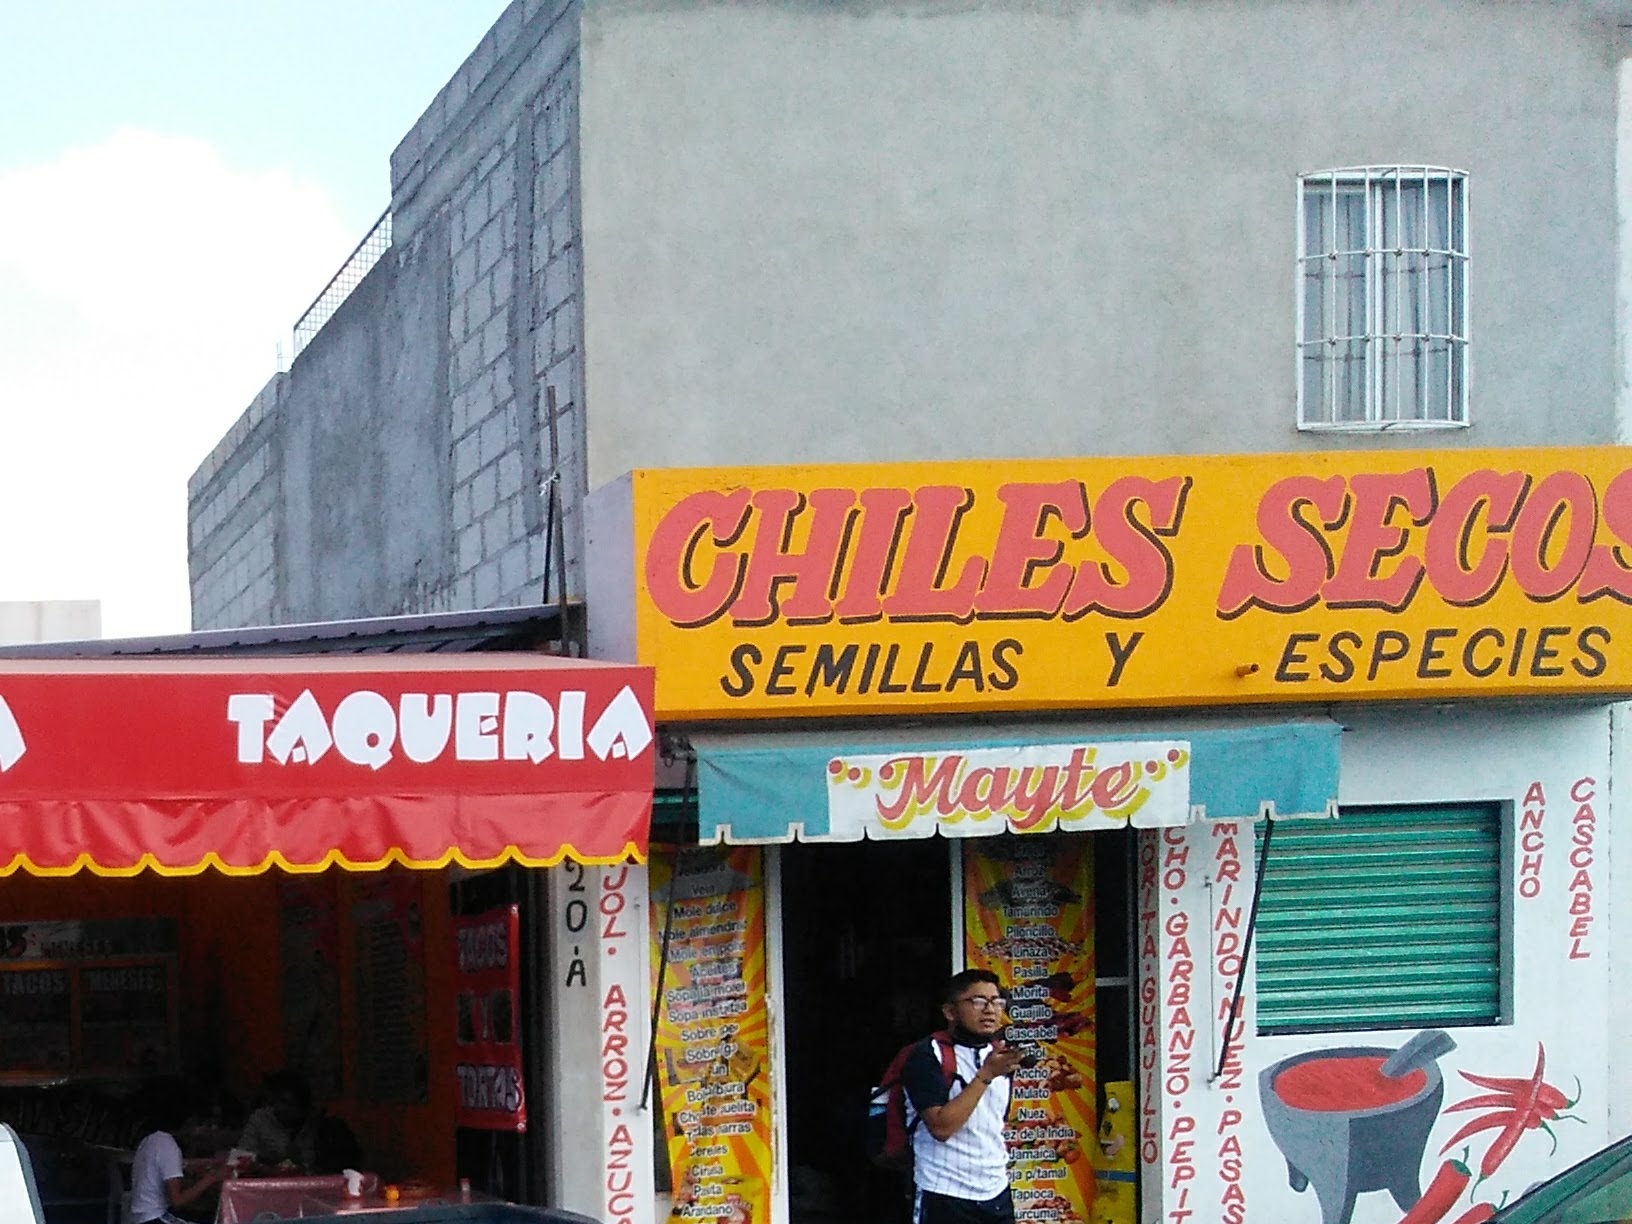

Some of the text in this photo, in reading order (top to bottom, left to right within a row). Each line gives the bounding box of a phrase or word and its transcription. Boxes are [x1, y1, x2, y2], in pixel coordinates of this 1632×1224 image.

[645, 476, 1194, 628] CHILES
[720, 626, 1612, 698] SEMILLAS Y ESPECIES
[226, 685, 654, 771] TAQUERIA
[875, 747, 1149, 833] Mayte
[1519, 781, 1546, 898] ANCHO
[1569, 776, 1597, 960] CASCABEL
[1140, 827, 1157, 960] MORITA
[674, 906, 703, 919] Mole
[1003, 905, 1059, 918] Tamarindo
[1005, 925, 1055, 938] Piloncillo
[1013, 945, 1048, 958] Linaza
[1013, 966, 1049, 978] Pasilla
[1013, 986, 1049, 999] Morita
[1165, 911, 1195, 1096] GARBANZO
[669, 1009, 701, 1023] Sopa
[1009, 1005, 1053, 1020] Guajillo
[681, 1028, 718, 1042] Sobre
[1005, 1026, 1058, 1040] Cascabel
[602, 984, 629, 1102] ARROZ
[1015, 1067, 1049, 1080] Ancho
[1014, 1088, 1049, 1100] Mulato
[1018, 1108, 1045, 1120] Nuez
[1020, 1128, 1034, 1140] de
[1036, 1126, 1046, 1139] la
[1048, 1125, 1074, 1139] India
[1010, 1148, 1056, 1161] Jamaica
[1025, 1166, 1067, 1181] p/tamal
[1011, 1188, 1054, 1202] Tapioca
